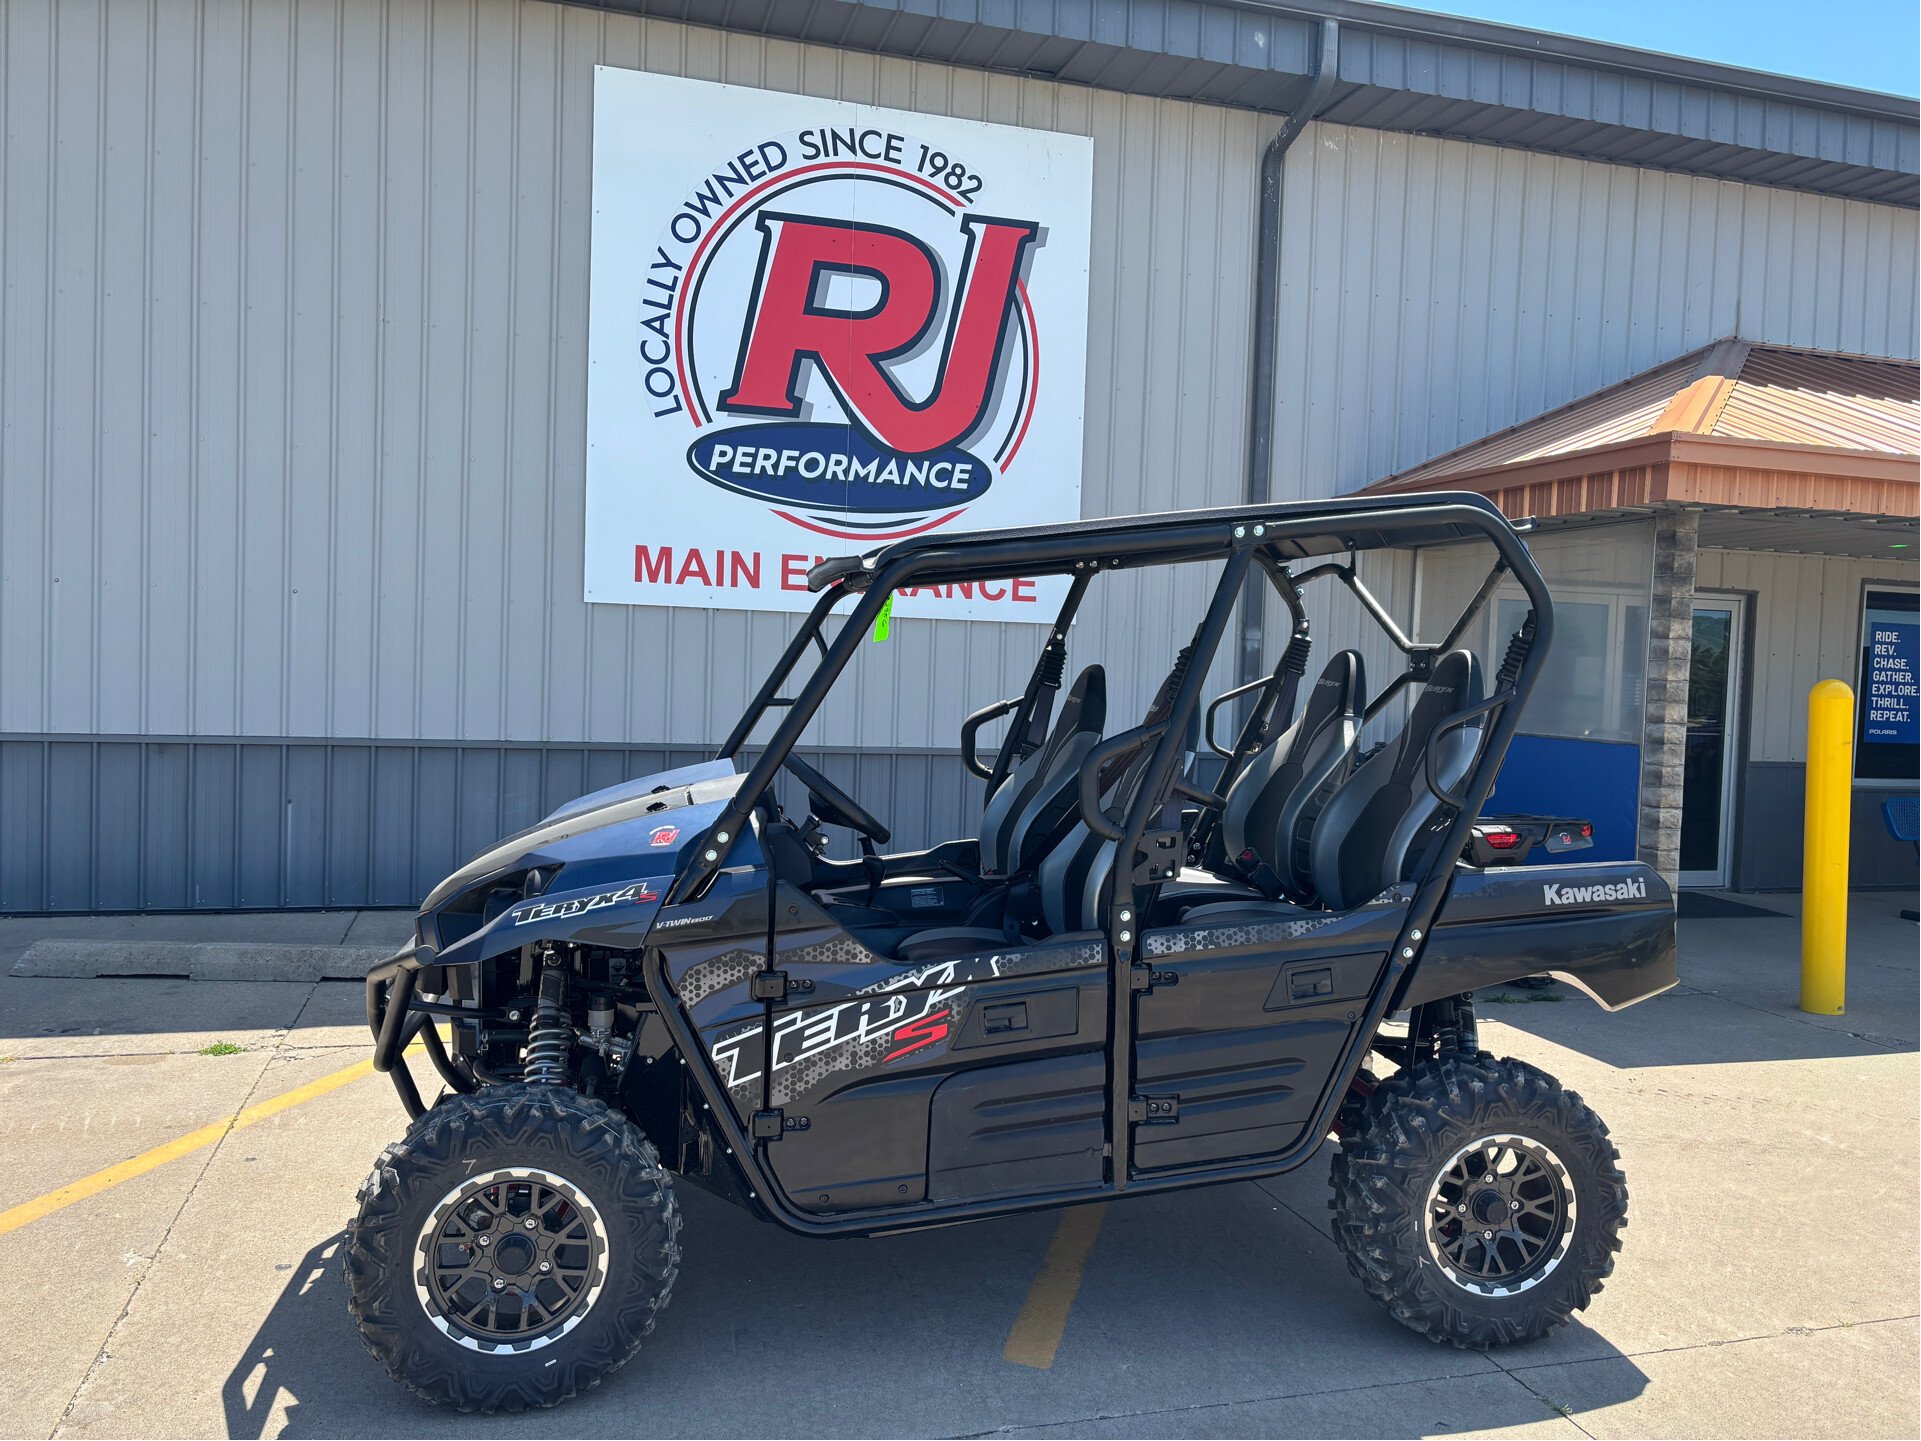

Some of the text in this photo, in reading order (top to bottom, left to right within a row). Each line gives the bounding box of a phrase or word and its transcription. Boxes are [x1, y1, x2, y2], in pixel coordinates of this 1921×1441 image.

[640, 127, 983, 418] LOCALLY OWNED SINCE 1982
[716, 210, 1042, 458] RJ
[709, 444, 973, 490] PERFORMANCE
[634, 545, 761, 589] MAIN
[1875, 631, 1901, 643] RIDE.
[1874, 645, 1897, 656] REV.
[1873, 658, 1910, 669] CHASE.
[1873, 671, 1915, 683] GATHER.
[1872, 684, 1920, 696] EXPLORE.
[1871, 697, 1909, 709] THRILL.
[1870, 710, 1911, 722] REPEAT.
[1869, 728, 1898, 736] POLARIS
[1543, 877, 1647, 906] Kawasaki
